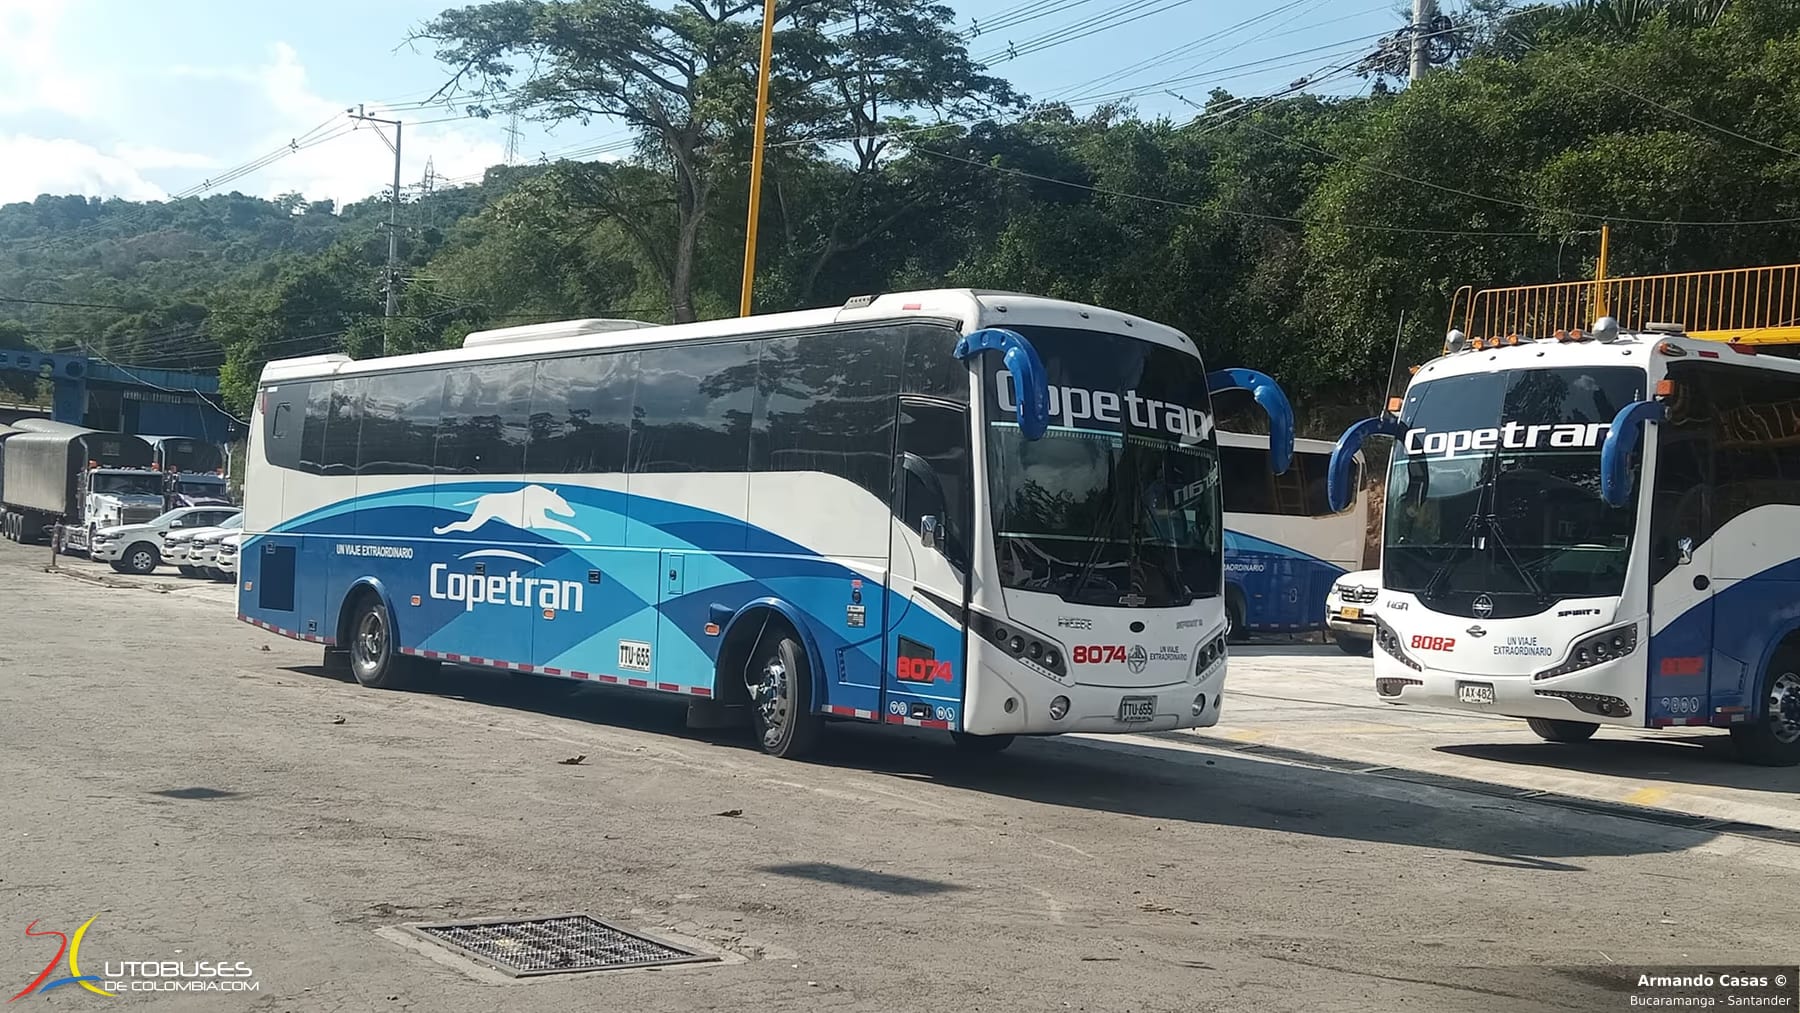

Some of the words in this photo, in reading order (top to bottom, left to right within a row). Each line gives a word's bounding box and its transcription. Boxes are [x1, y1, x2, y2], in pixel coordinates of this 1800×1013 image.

[345, 545, 361, 556] VIAJE
[362, 545, 414, 559] EXTRAORDINARIO
[430, 563, 583, 612] Copetran
[1411, 635, 1456, 652] 8082
[1507, 637, 1517, 646] UN
[1518, 637, 1537, 646] VIAJE
[1073, 645, 1127, 663] 8074
[1493, 645, 1553, 657] EXTRAORDINARIO
[897, 656, 953, 682] 8074
